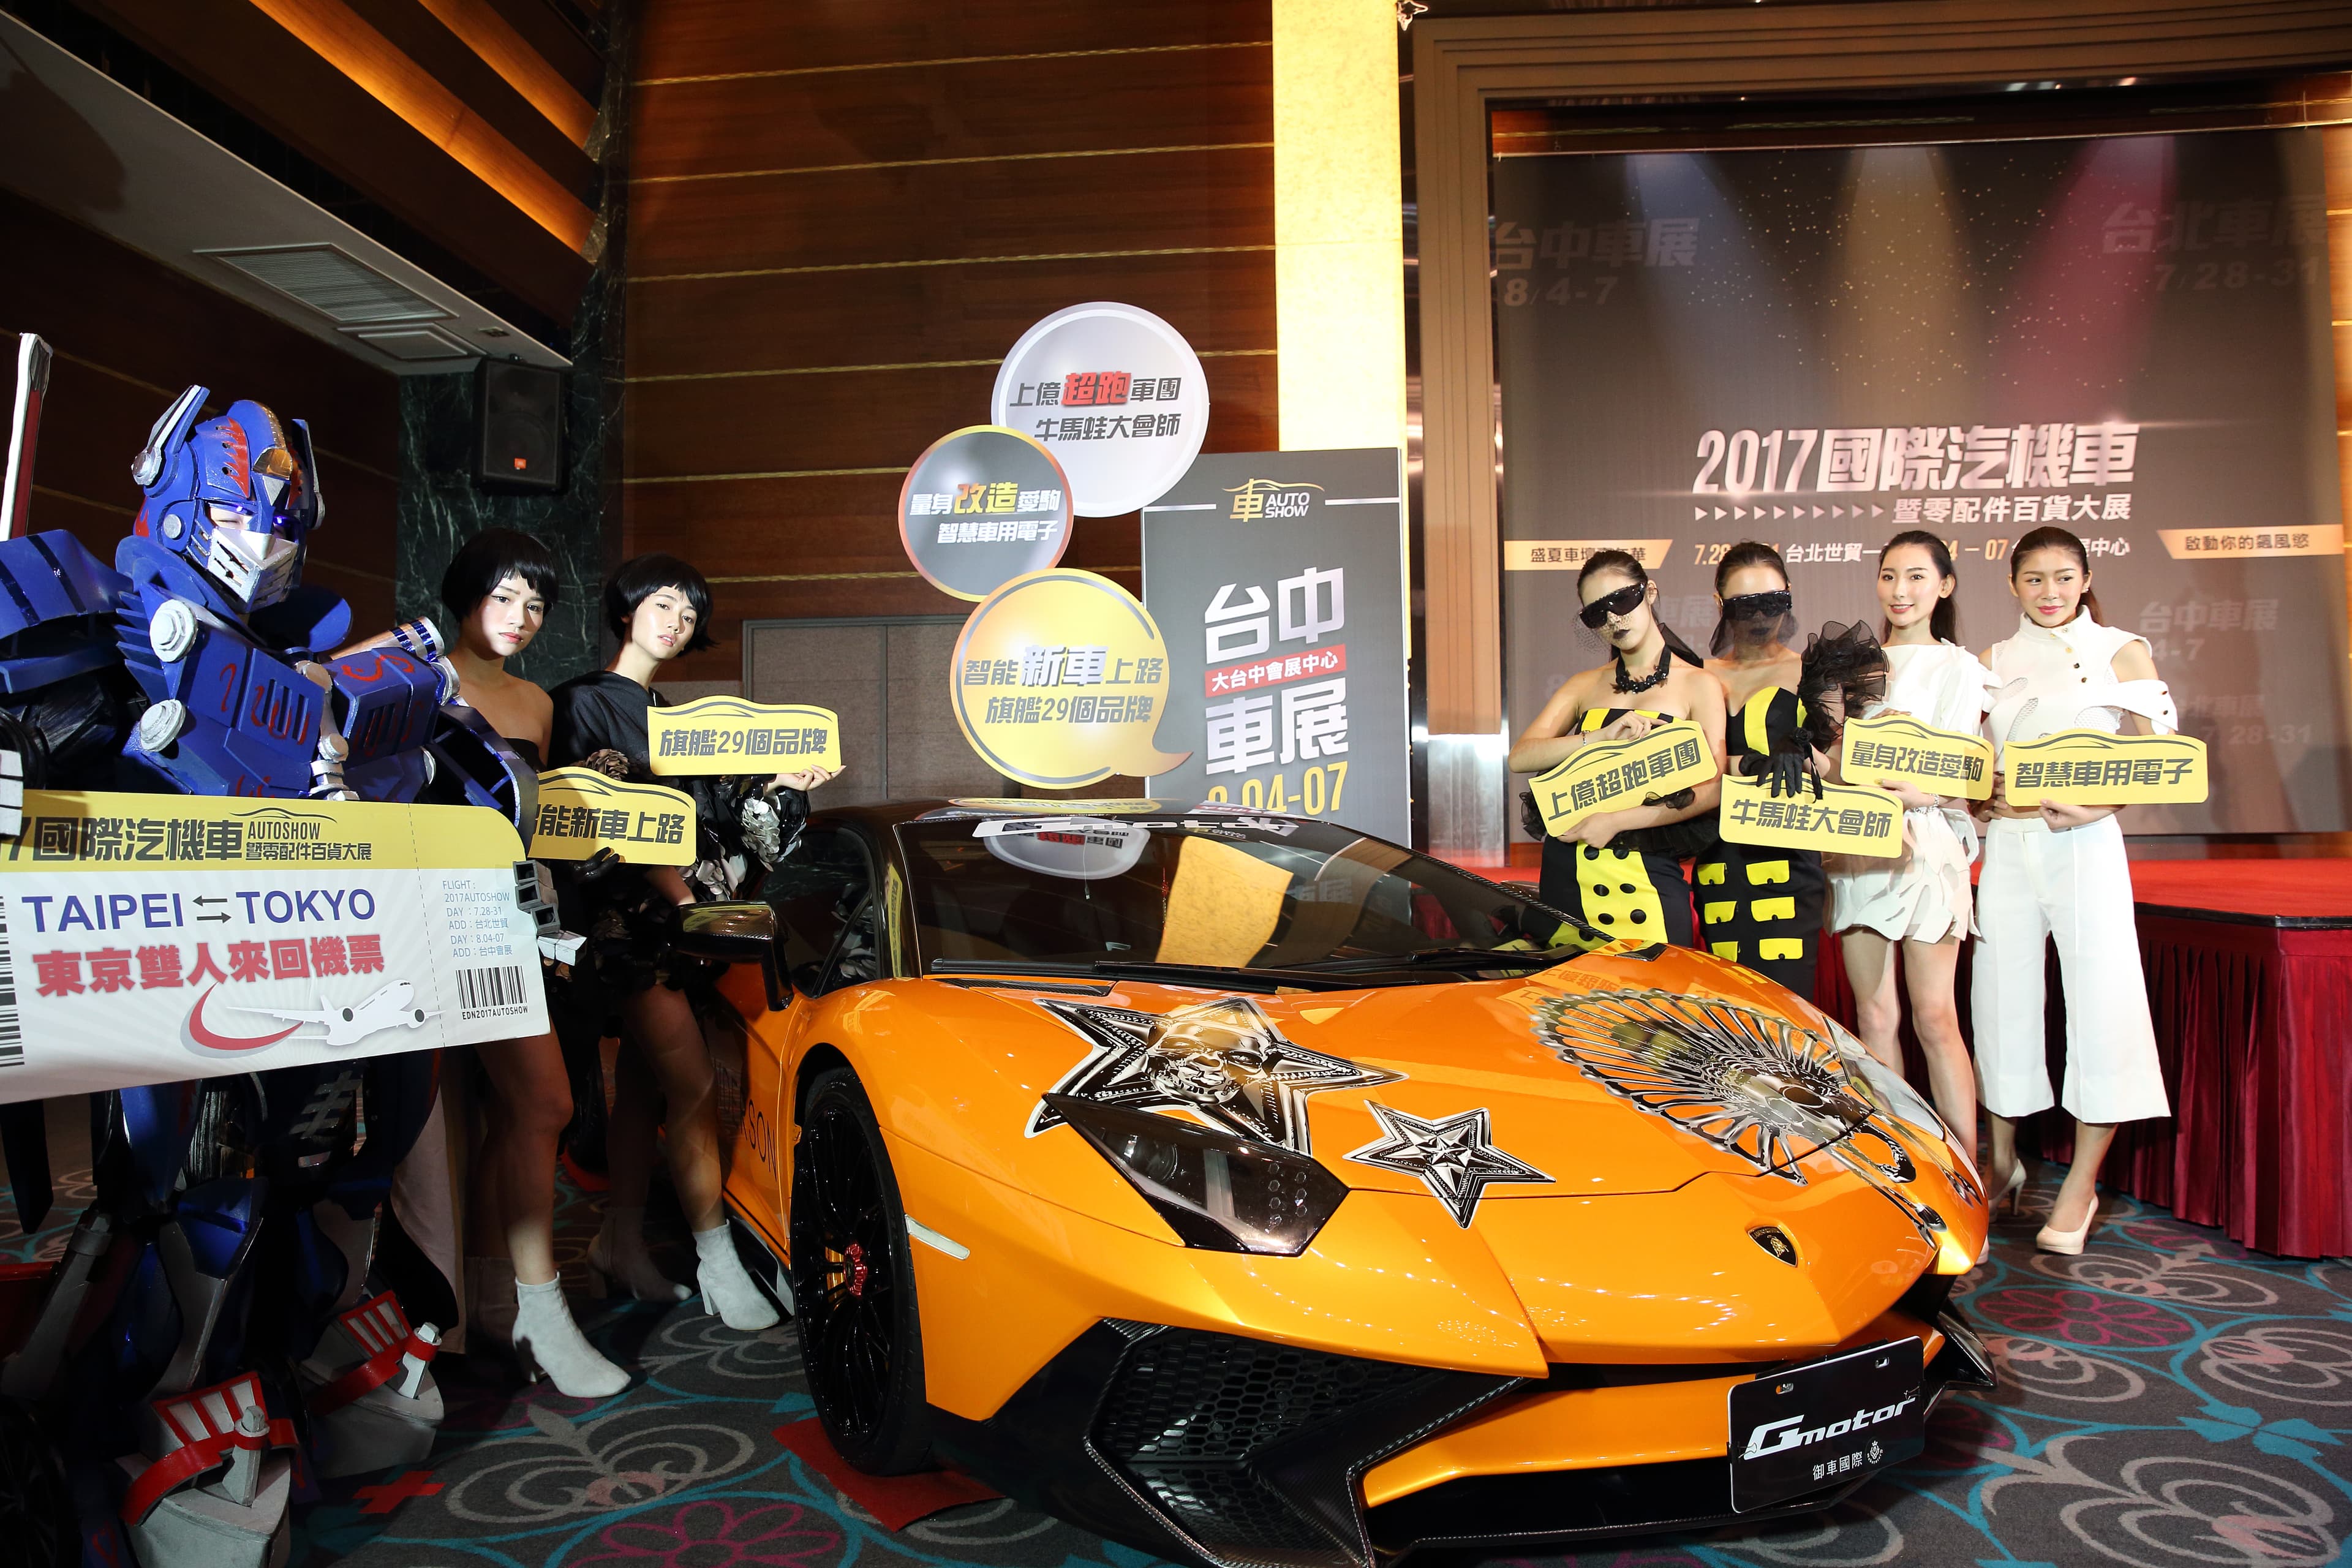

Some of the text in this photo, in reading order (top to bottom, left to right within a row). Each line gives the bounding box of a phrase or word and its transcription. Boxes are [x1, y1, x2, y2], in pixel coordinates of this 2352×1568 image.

[1496, 217, 1701, 270] 台中車展
[1503, 276, 1619, 308] 8/4-7
[1009, 371, 1182, 407] 上億超跑軍團
[1034, 413, 1182, 441] 牛馬蛙大會師
[910, 482, 1061, 516] 量身改造愛駒
[1265, 492, 1310, 507] AUTO
[1265, 505, 1308, 518] SHOW
[1893, 493, 2132, 524] 暨零配件百貨大展
[937, 520, 1058, 544] 智慧車用電子
[1531, 547, 1646, 562] 盛夏車壇華
[1786, 542, 1889, 563] 台北世貿一
[1205, 567, 1345, 665] 台中
[2139, 598, 2279, 634] 台中車展
[963, 644, 1164, 687] 智能新車上路
[1212, 651, 1338, 692] 大台中會展中心
[985, 696, 1154, 724] 旗艦29個品牌
[1205, 677, 1349, 775] 車展
[658, 729, 827, 756] 旗艦29個品牌
[1850, 740, 1985, 782] 量身改造愛駒
[2015, 758, 2194, 788] 智慧車用電子
[1548, 737, 1702, 821] 上億超跑軍團
[248, 822, 320, 840] AUTOSHOW
[1730, 799, 1893, 839] 牛馬蛙大會師
[246, 842, 372, 861] 暨零配件百貨大展
[22, 888, 376, 932] TAIPEI TOKYO
[445, 892, 510, 902] 2017AUTOSHOW
[32, 934, 385, 998] 東京雙人來回機票
[462, 1005, 529, 1020] EDN2017AUTOSHOW
[1743, 1396, 1915, 1460] Gmotor
[1812, 1451, 1863, 1482] 御車國際
